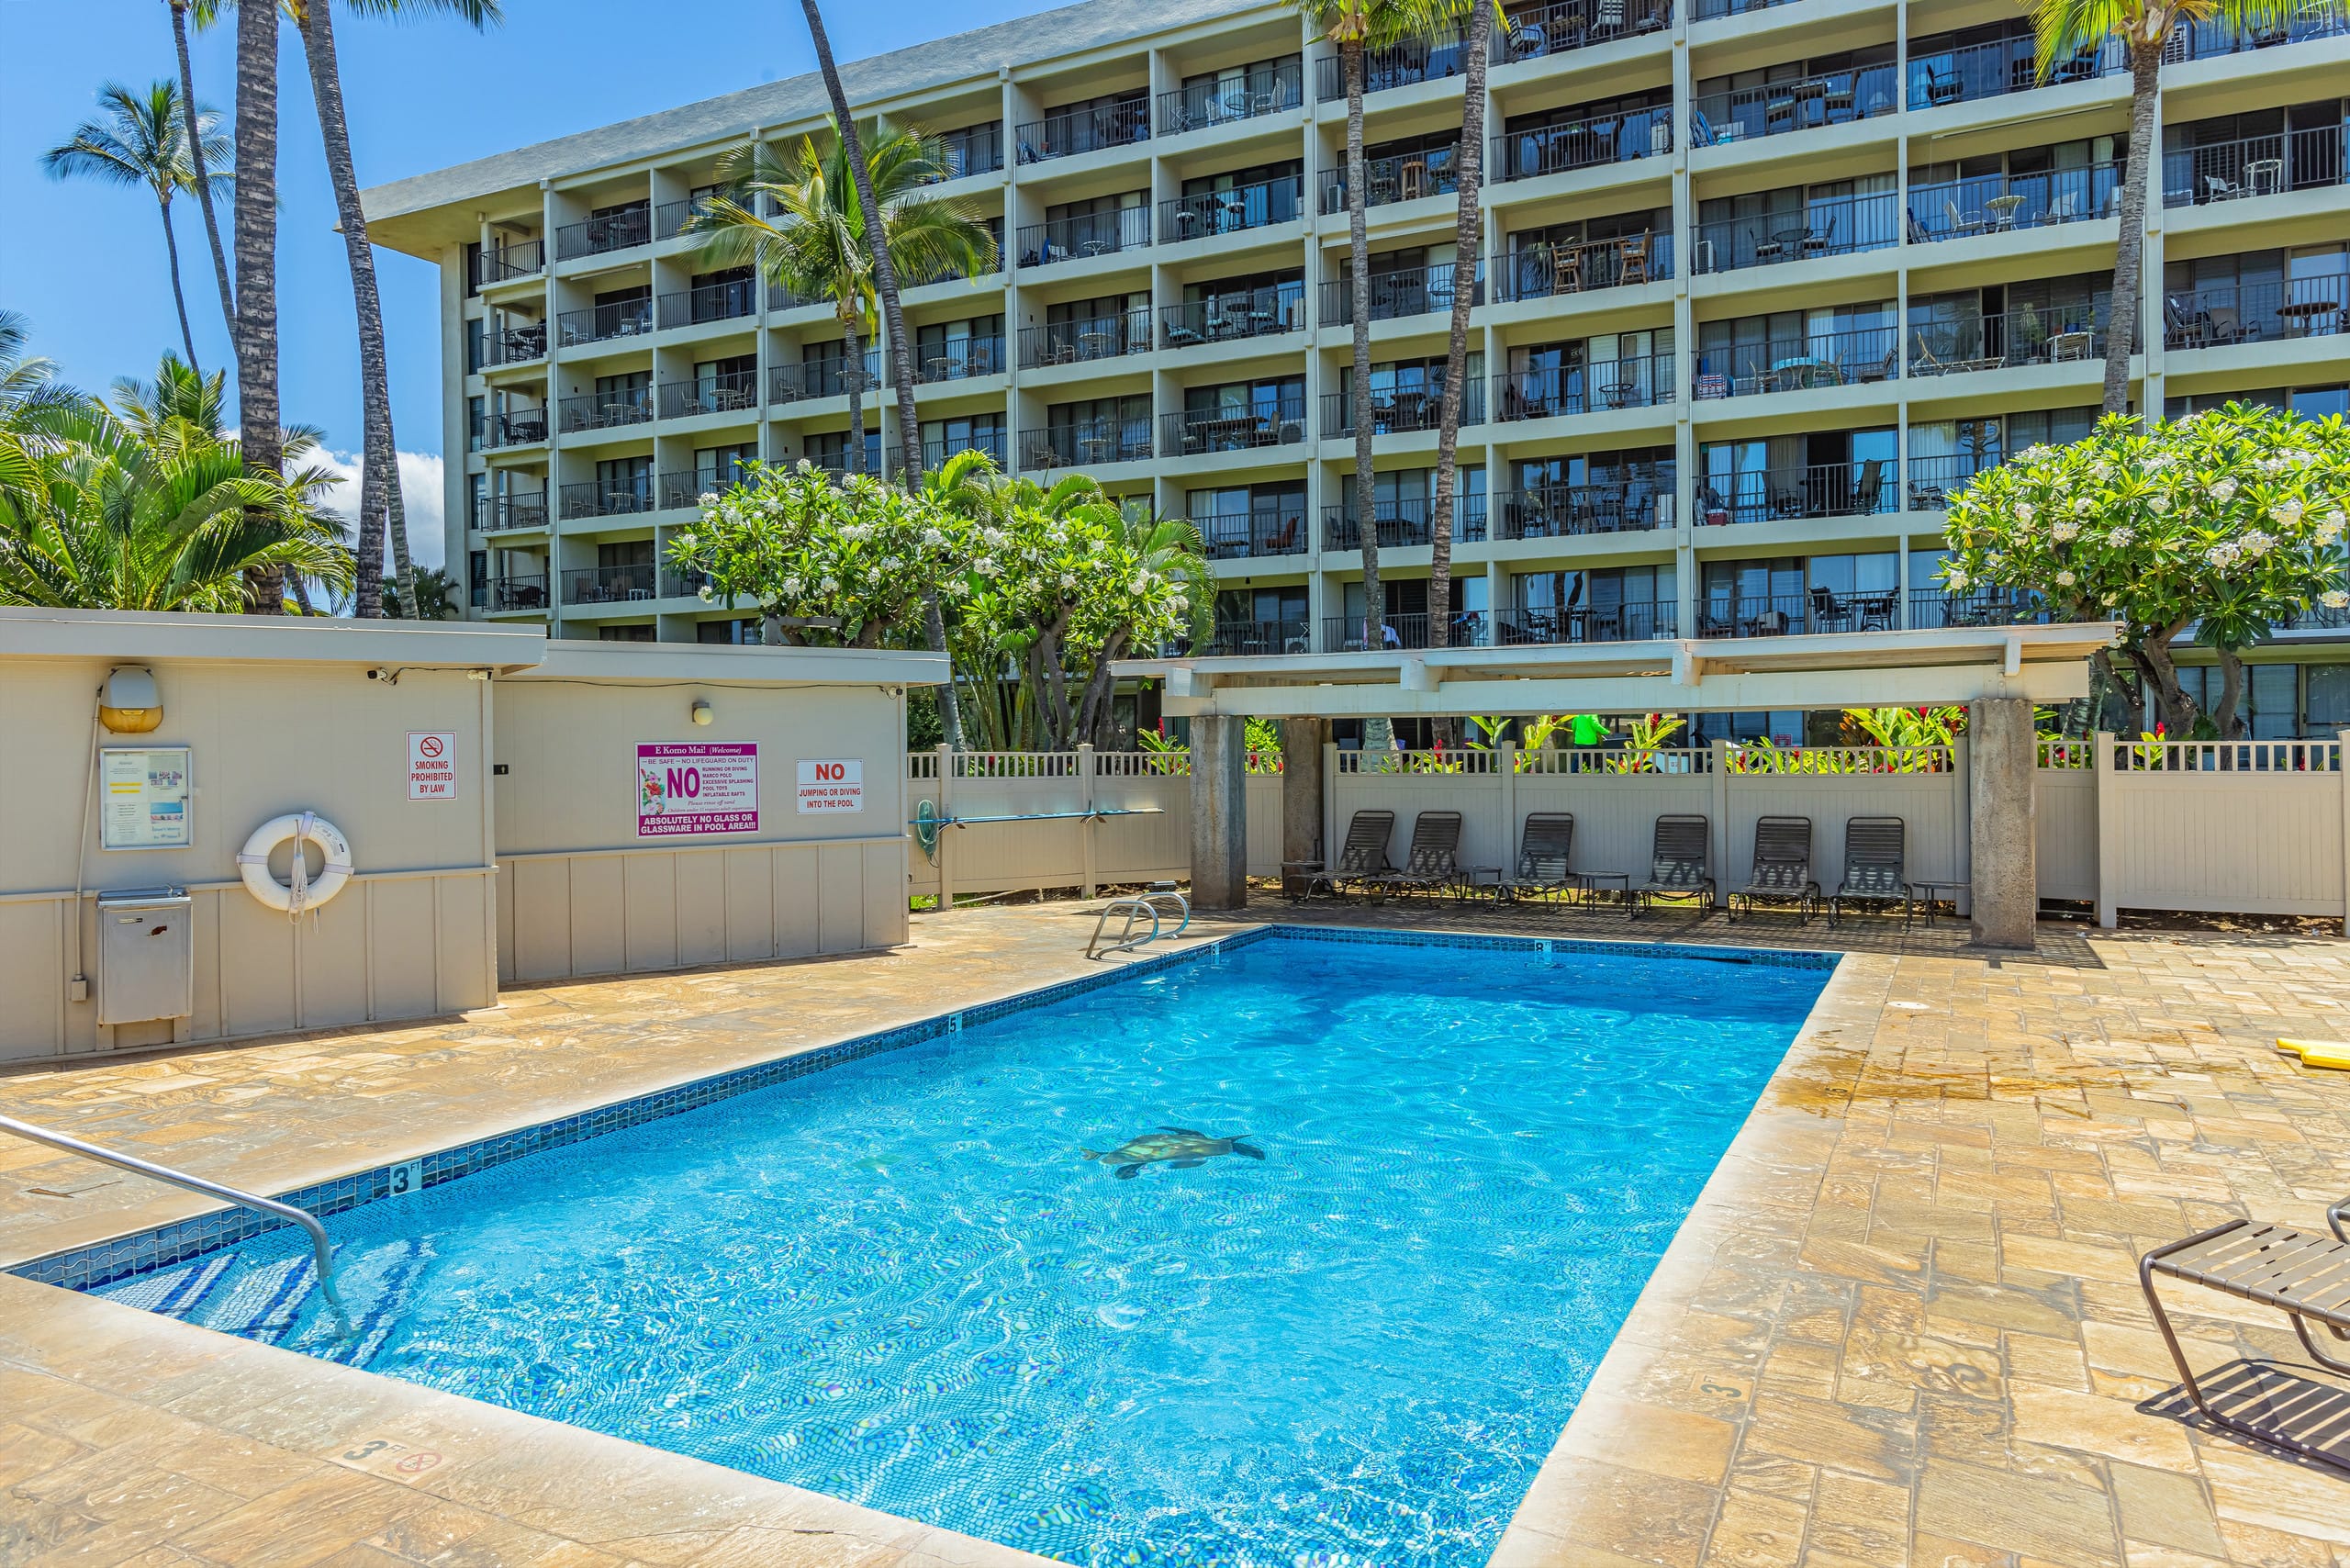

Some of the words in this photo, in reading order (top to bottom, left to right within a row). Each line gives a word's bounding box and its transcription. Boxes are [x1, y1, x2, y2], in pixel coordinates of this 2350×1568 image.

[689, 745, 705, 754] Mai!
[710, 745, 742, 755] (Welcome)
[415, 761, 448, 769] SMOKING
[411, 772, 453, 781] PROHIBITED
[816, 763, 845, 780] NO
[667, 767, 700, 798] NO
[420, 785, 429, 793] BY
[431, 784, 445, 792] LAW
[800, 789, 828, 797] JUMPING
[840, 788, 861, 796] DIVING
[823, 800, 836, 808] THE
[644, 816, 698, 824] ABSOLUTELY
[641, 824, 692, 834] GLASSWARE
[728, 822, 756, 830] AREA!!!
[950, 1016, 957, 1033] 5
[394, 1167, 408, 1193] 3
[411, 1161, 420, 1172] FT
[1700, 1384, 1741, 1397] 3
[342, 1440, 388, 1460] 3
